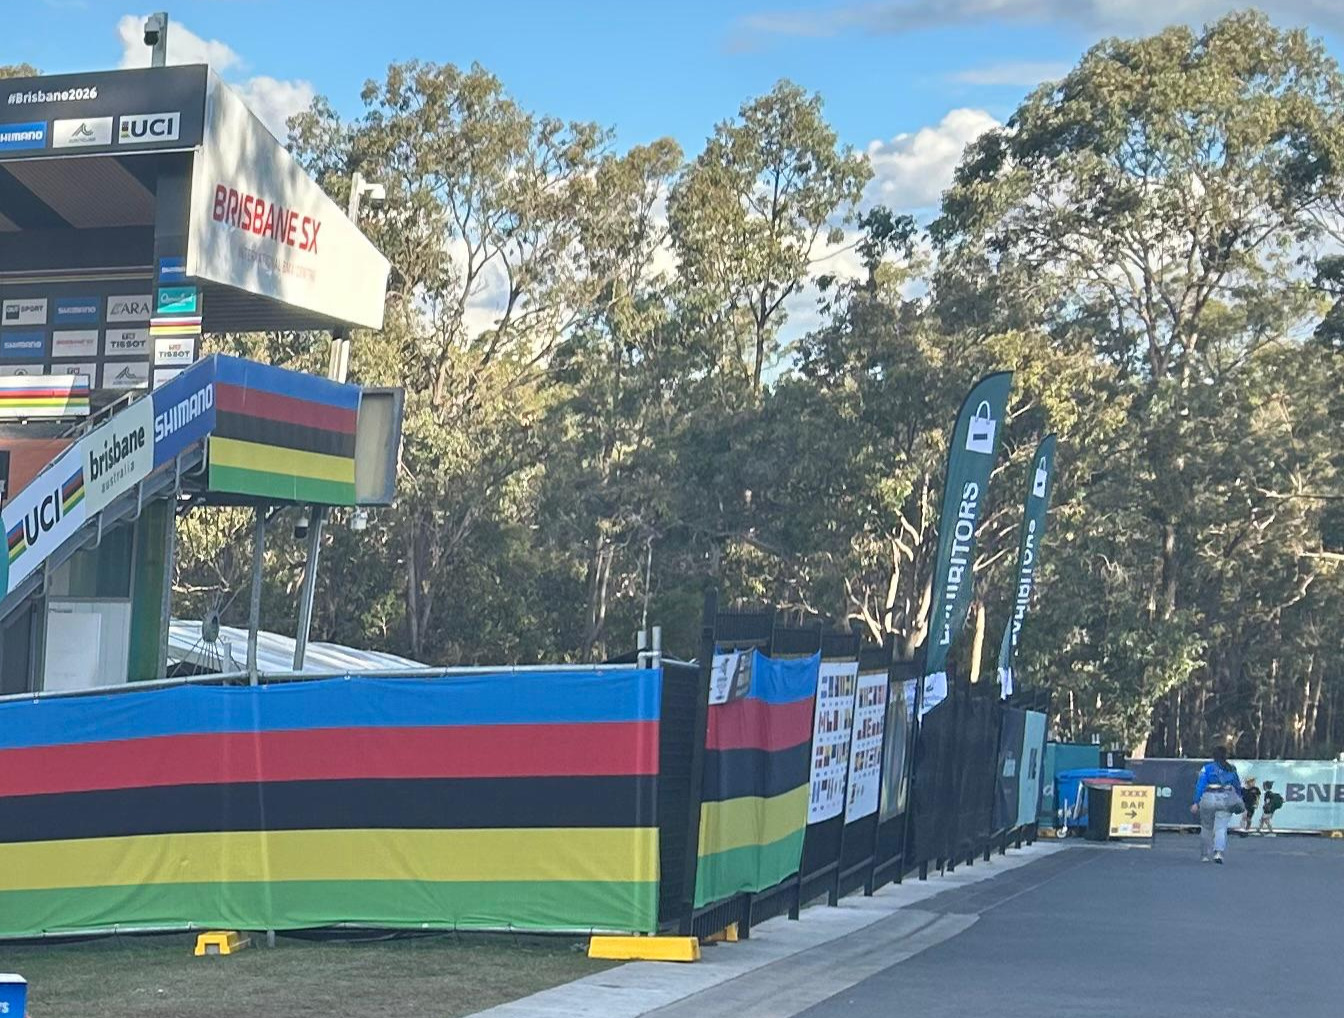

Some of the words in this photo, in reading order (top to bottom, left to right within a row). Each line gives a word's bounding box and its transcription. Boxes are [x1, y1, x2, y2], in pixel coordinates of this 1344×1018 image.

[8, 87, 98, 105] #Brisbane2026
[130, 118, 173, 138] UCI
[213, 184, 300, 247] BRISBANE
[299, 215, 322, 255] SX
[21, 305, 44, 314] SPORT
[110, 340, 146, 349] TISSOT
[159, 350, 191, 358] TISSOT
[154, 383, 213, 443] SHIMANO
[89, 423, 145, 482] brisbane
[101, 460, 135, 493] australia
[23, 489, 61, 547] UCI
[1120, 801, 1145, 809] BAR
